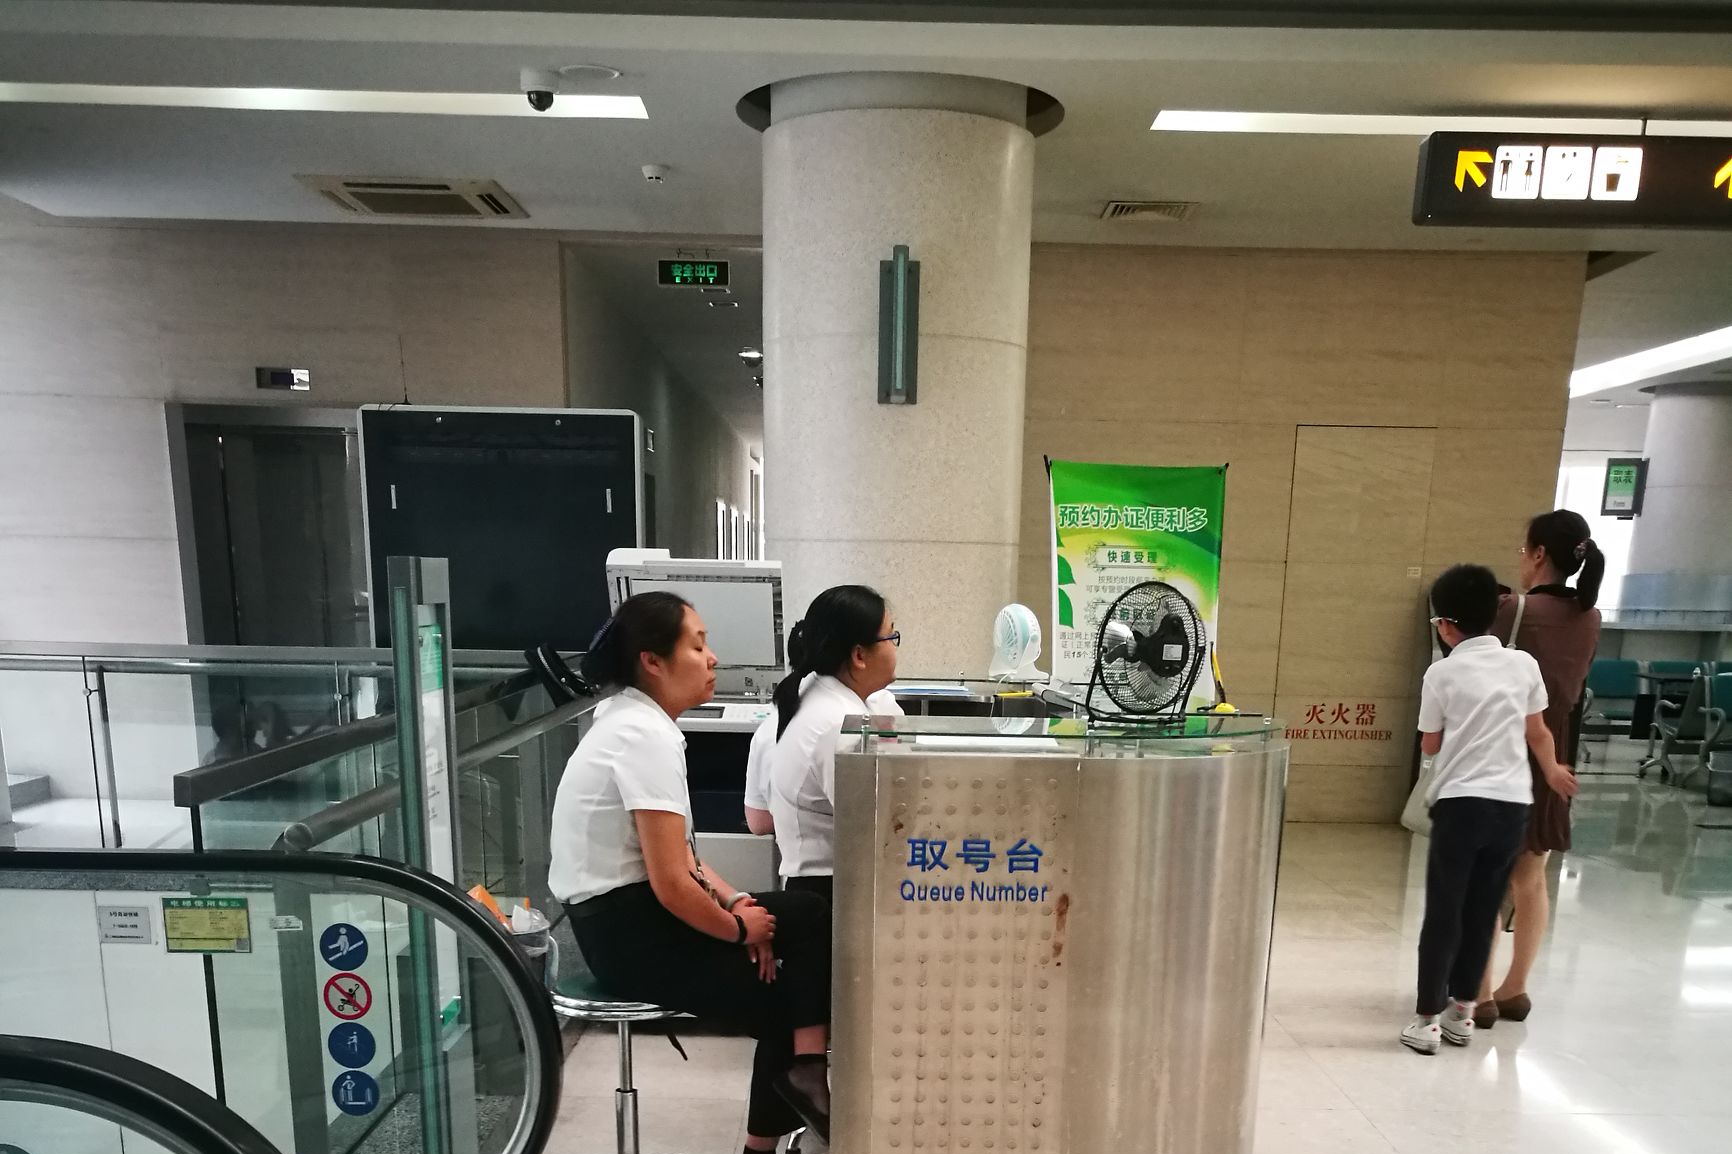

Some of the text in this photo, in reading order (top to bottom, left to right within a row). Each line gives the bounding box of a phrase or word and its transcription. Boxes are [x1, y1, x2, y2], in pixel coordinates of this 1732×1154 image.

[671, 264, 718, 277] 安全出口
[1059, 504, 1208, 532] 预约办证便利多
[1107, 550, 1158, 564] 快速受理
[1304, 703, 1376, 725] 灭火器
[1285, 729, 1392, 741] FIRE EXTINGUISHER
[907, 838, 1043, 873] 取号台
[900, 879, 1048, 902] Queue Number
